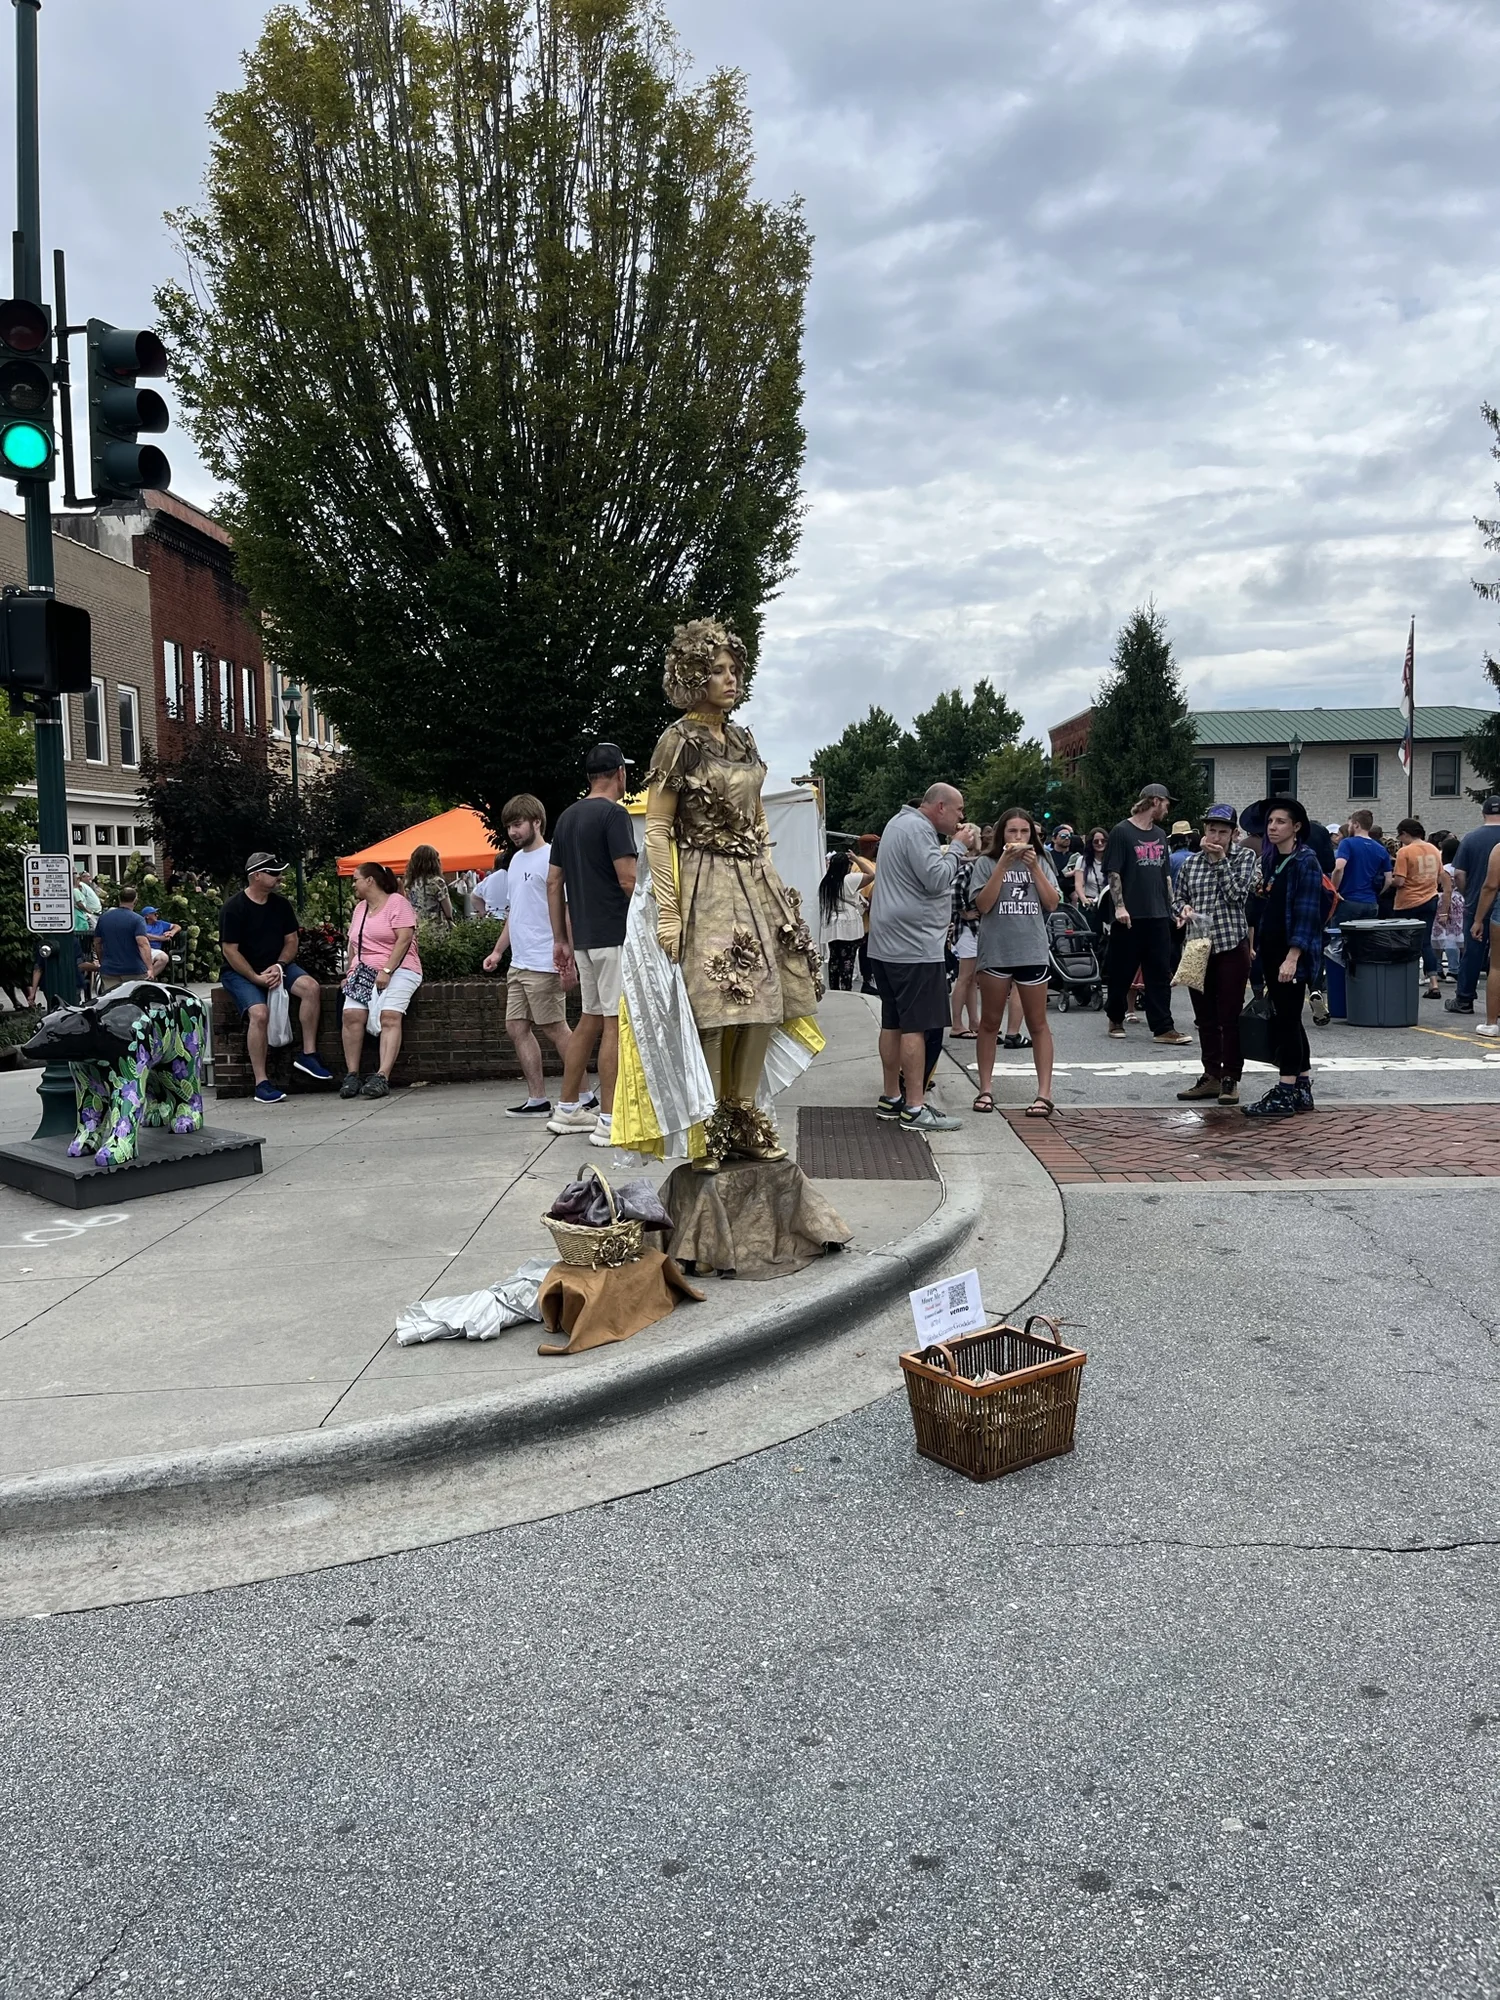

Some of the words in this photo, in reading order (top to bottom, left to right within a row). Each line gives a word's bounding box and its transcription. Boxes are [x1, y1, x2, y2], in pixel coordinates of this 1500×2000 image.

[1134, 842, 1164, 859] WTF
[1416, 854, 1437, 874] 19
[998, 901, 1039, 915] ATHLETICS
[949, 1305, 970, 1316] venmo
